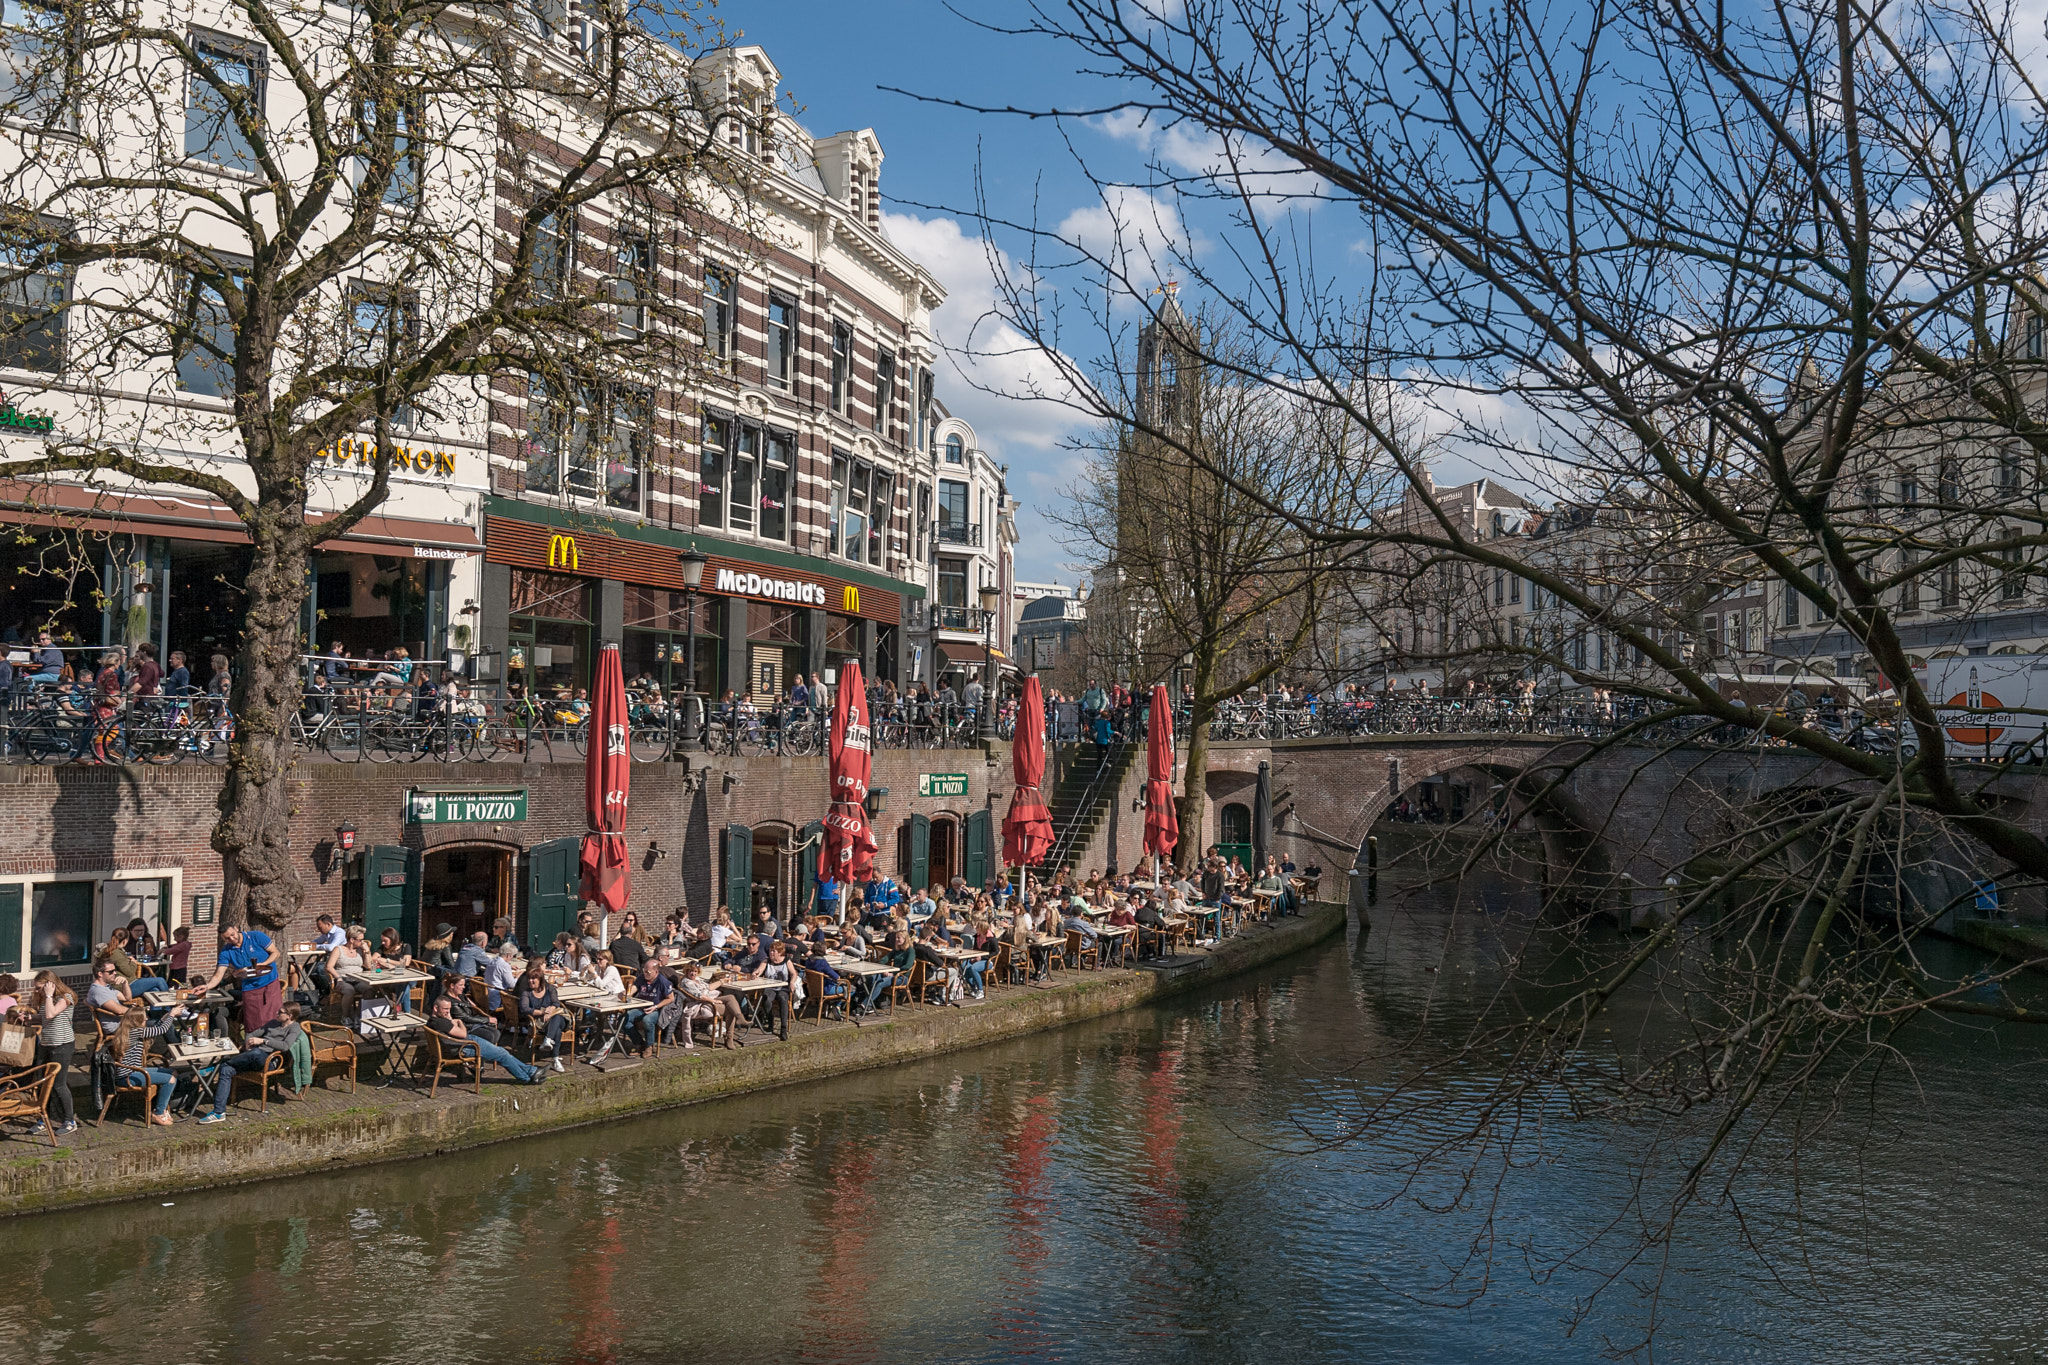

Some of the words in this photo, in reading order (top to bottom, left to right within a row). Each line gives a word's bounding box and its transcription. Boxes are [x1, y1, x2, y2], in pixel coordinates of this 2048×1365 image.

[414, 547, 467, 559] Heineken
[715, 569, 826, 605] McDonald's
[1988, 714, 2012, 723] Ben
[837, 775, 854, 787] OP
[934, 782, 941, 794] IL
[942, 781, 963, 794] POZZO
[438, 793, 476, 802] Pizzeria
[478, 793, 524, 801] Ristorante
[447, 803, 462, 820] IL
[465, 802, 516, 820] POZZO
[826, 811, 861, 832] OZZO
[382, 875, 405, 884] OPEN
